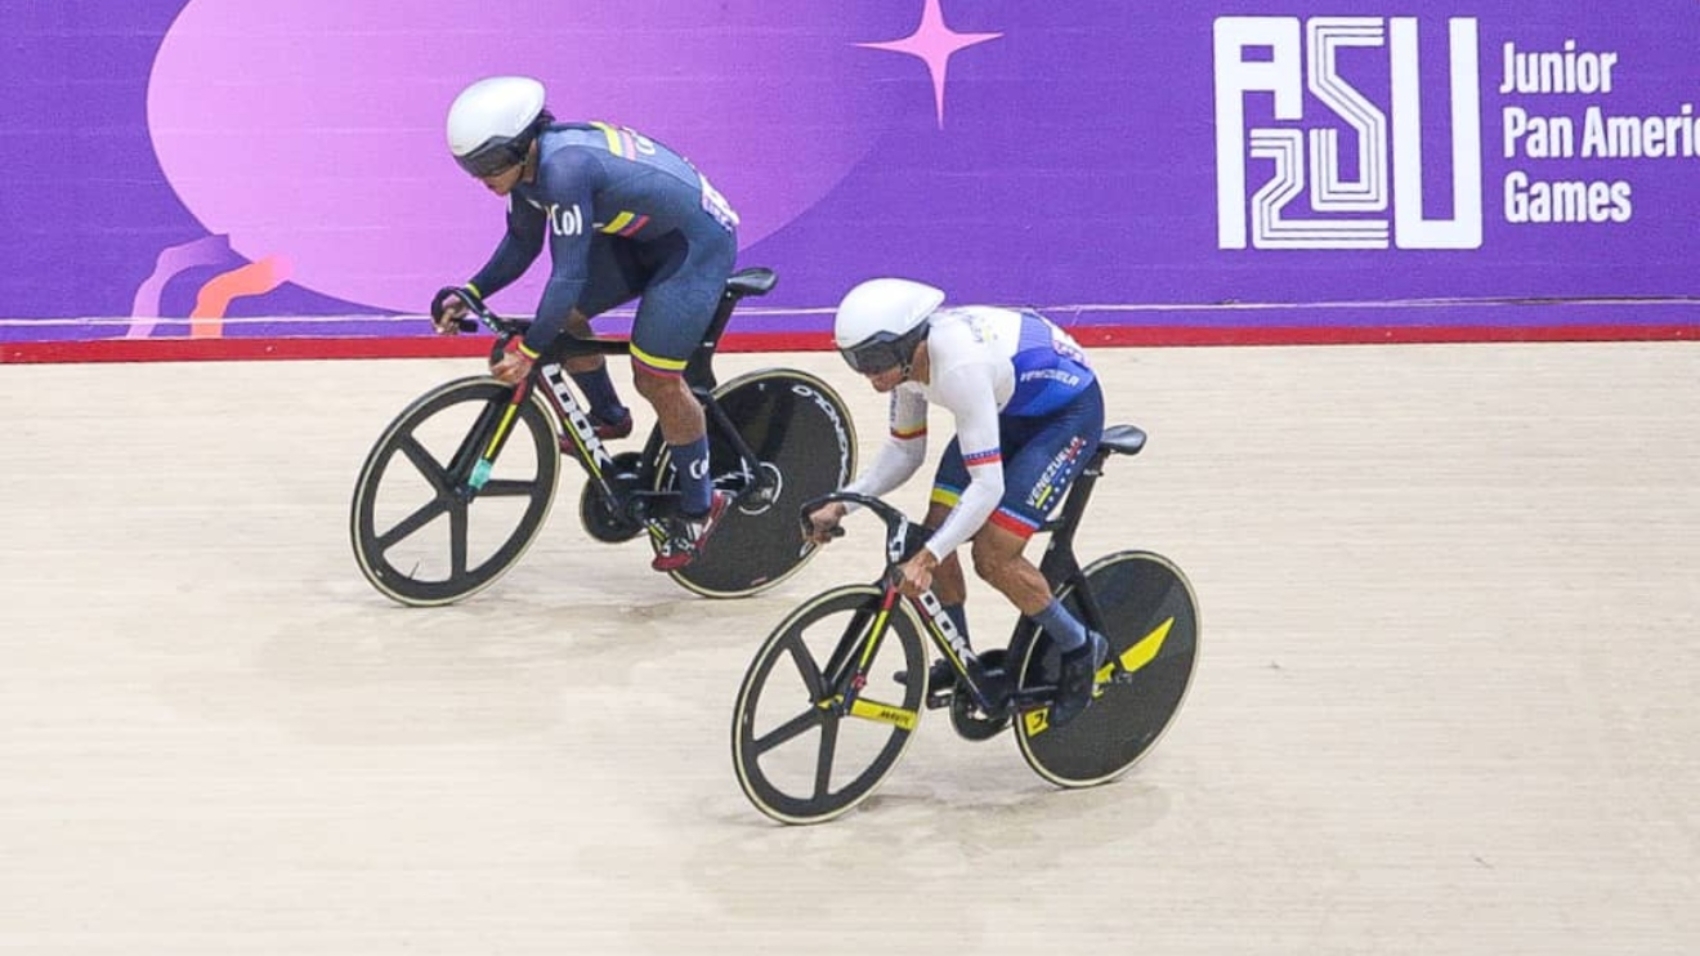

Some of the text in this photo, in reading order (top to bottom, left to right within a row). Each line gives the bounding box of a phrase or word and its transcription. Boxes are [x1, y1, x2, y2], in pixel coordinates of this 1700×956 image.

[1499, 39, 1618, 93] Junior
[1502, 106, 1574, 158] Pan
[550, 203, 583, 235] Col
[1504, 170, 1632, 223] Games
[541, 363, 613, 470] LOOK
[1025, 435, 1080, 507] VENEZUELA
[919, 590, 978, 668] OOK
